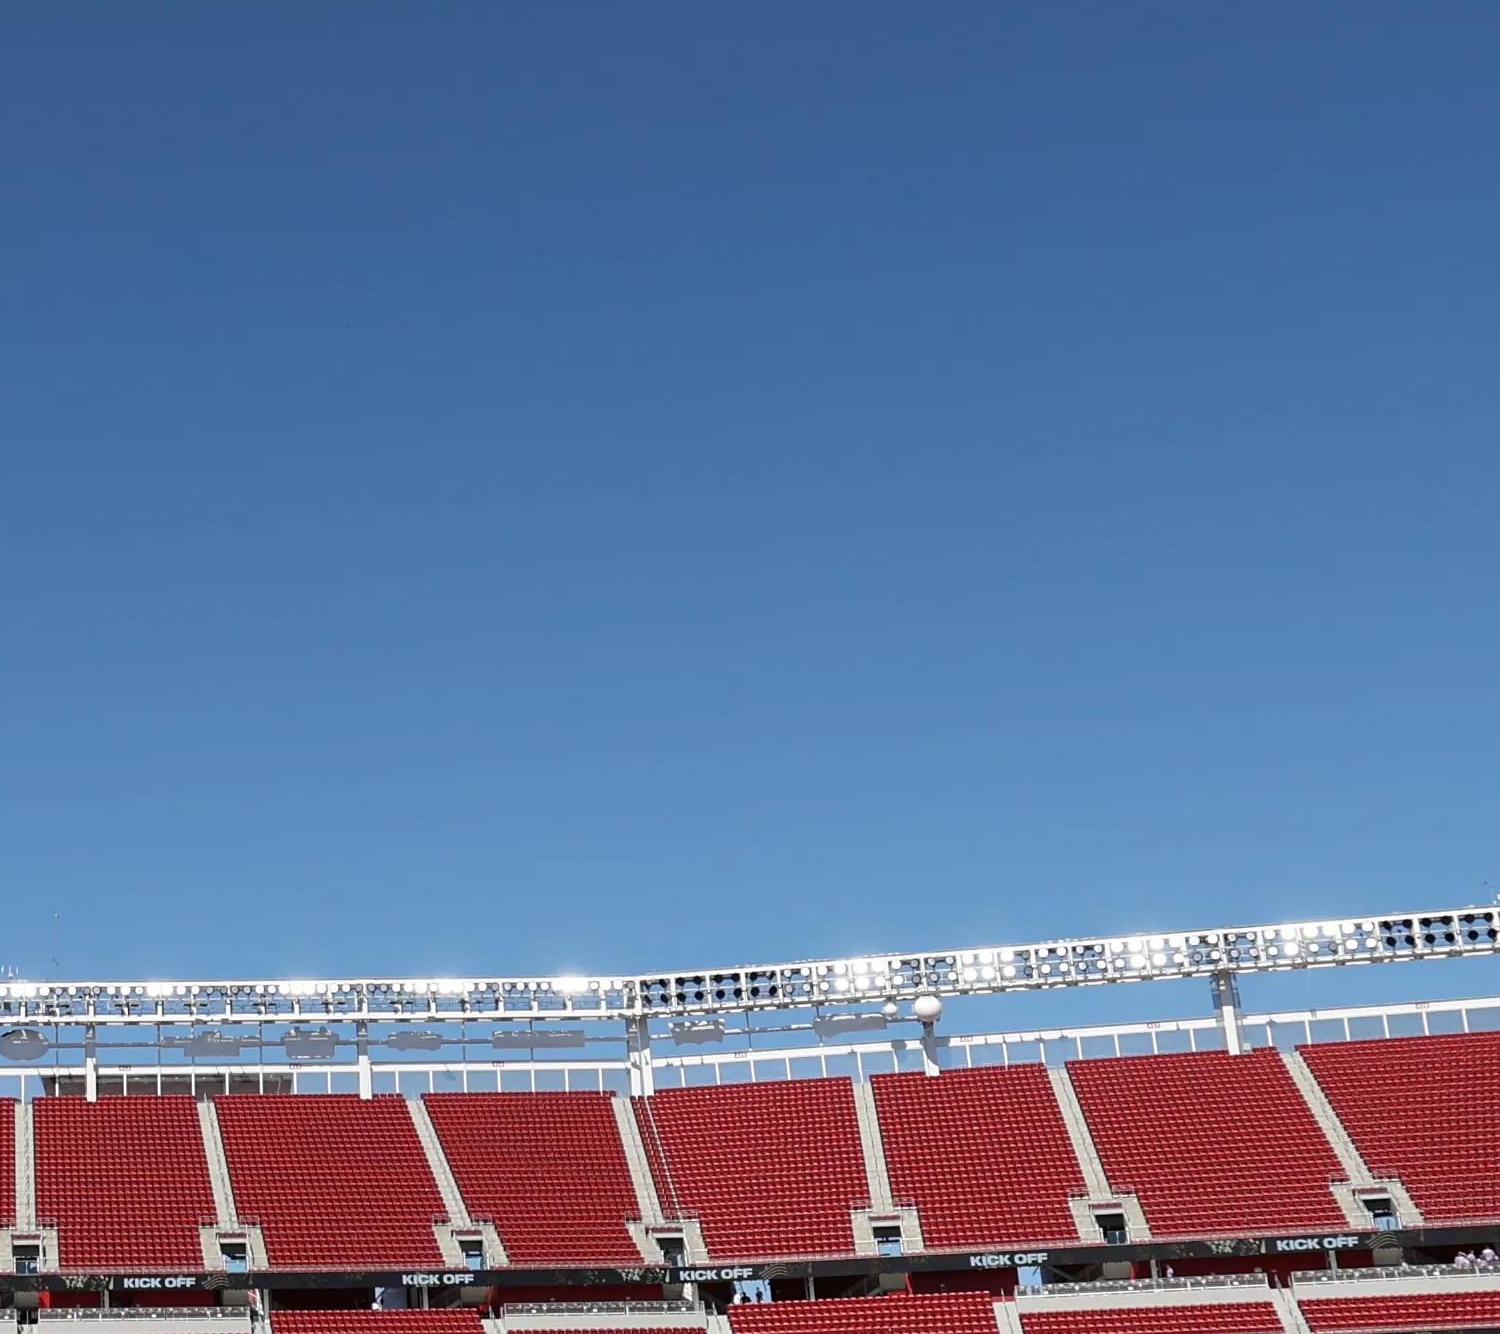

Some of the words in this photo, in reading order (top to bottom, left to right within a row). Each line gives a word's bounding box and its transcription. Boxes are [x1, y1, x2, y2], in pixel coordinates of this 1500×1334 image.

[1276, 1238, 1321, 1251] KICK
[1323, 1235, 1358, 1248] OFF
[970, 1254, 1011, 1268] KICK
[1014, 1252, 1048, 1265] OFF
[402, 1272, 440, 1287] KICK
[443, 1273, 474, 1284] OFF
[680, 1269, 718, 1281] KICK
[721, 1267, 753, 1279] OFF
[124, 1278, 161, 1288] KICK
[165, 1276, 196, 1287] OFF
